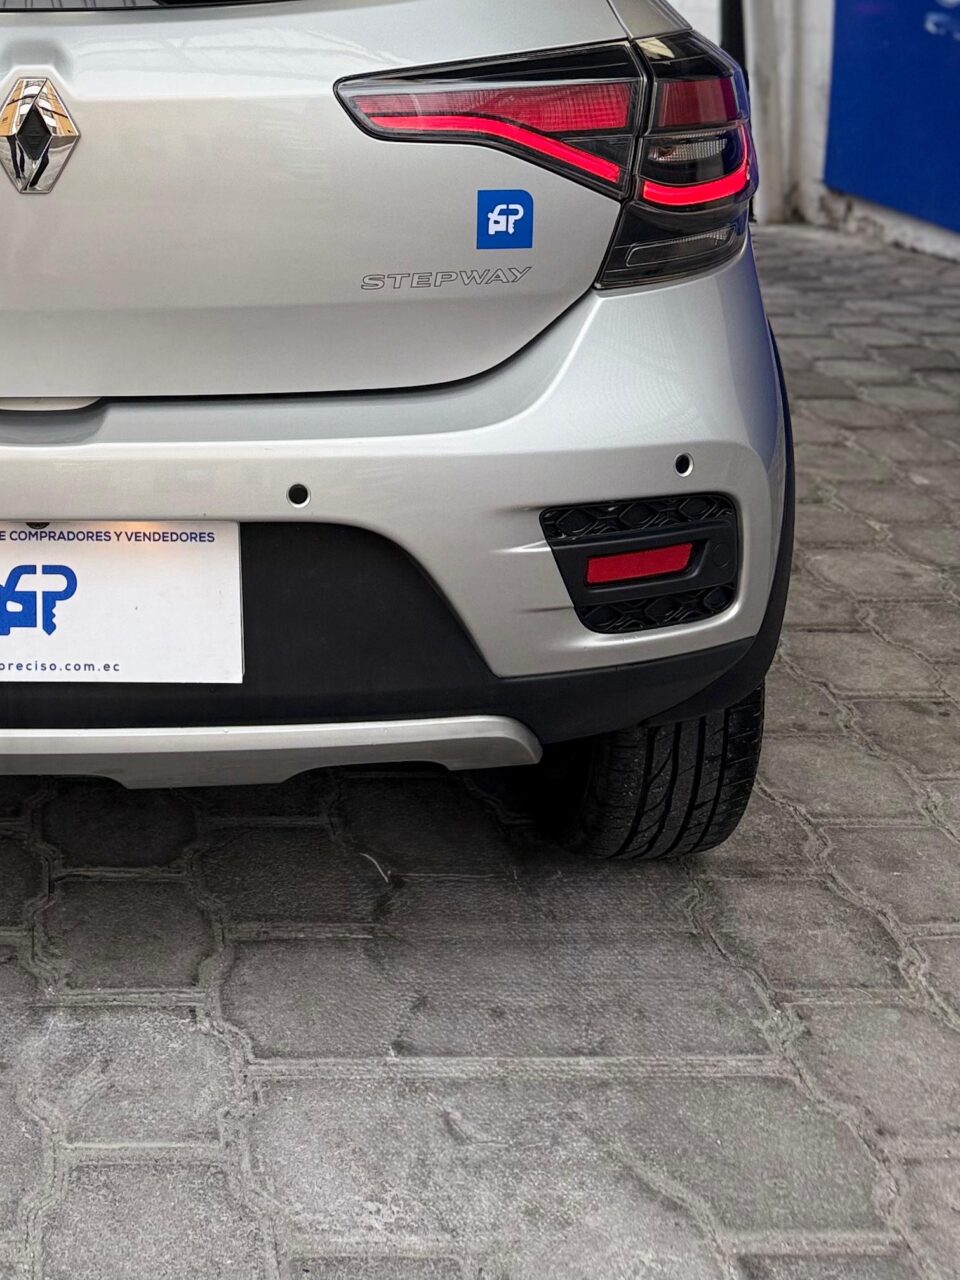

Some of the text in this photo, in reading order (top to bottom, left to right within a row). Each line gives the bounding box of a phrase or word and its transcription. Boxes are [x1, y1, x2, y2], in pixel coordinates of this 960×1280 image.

[360, 266, 535, 291] STEPWAY
[9, 530, 112, 542] COMPRADORES
[115, 531, 123, 542] Y
[125, 530, 216, 543] VENDEDORES
